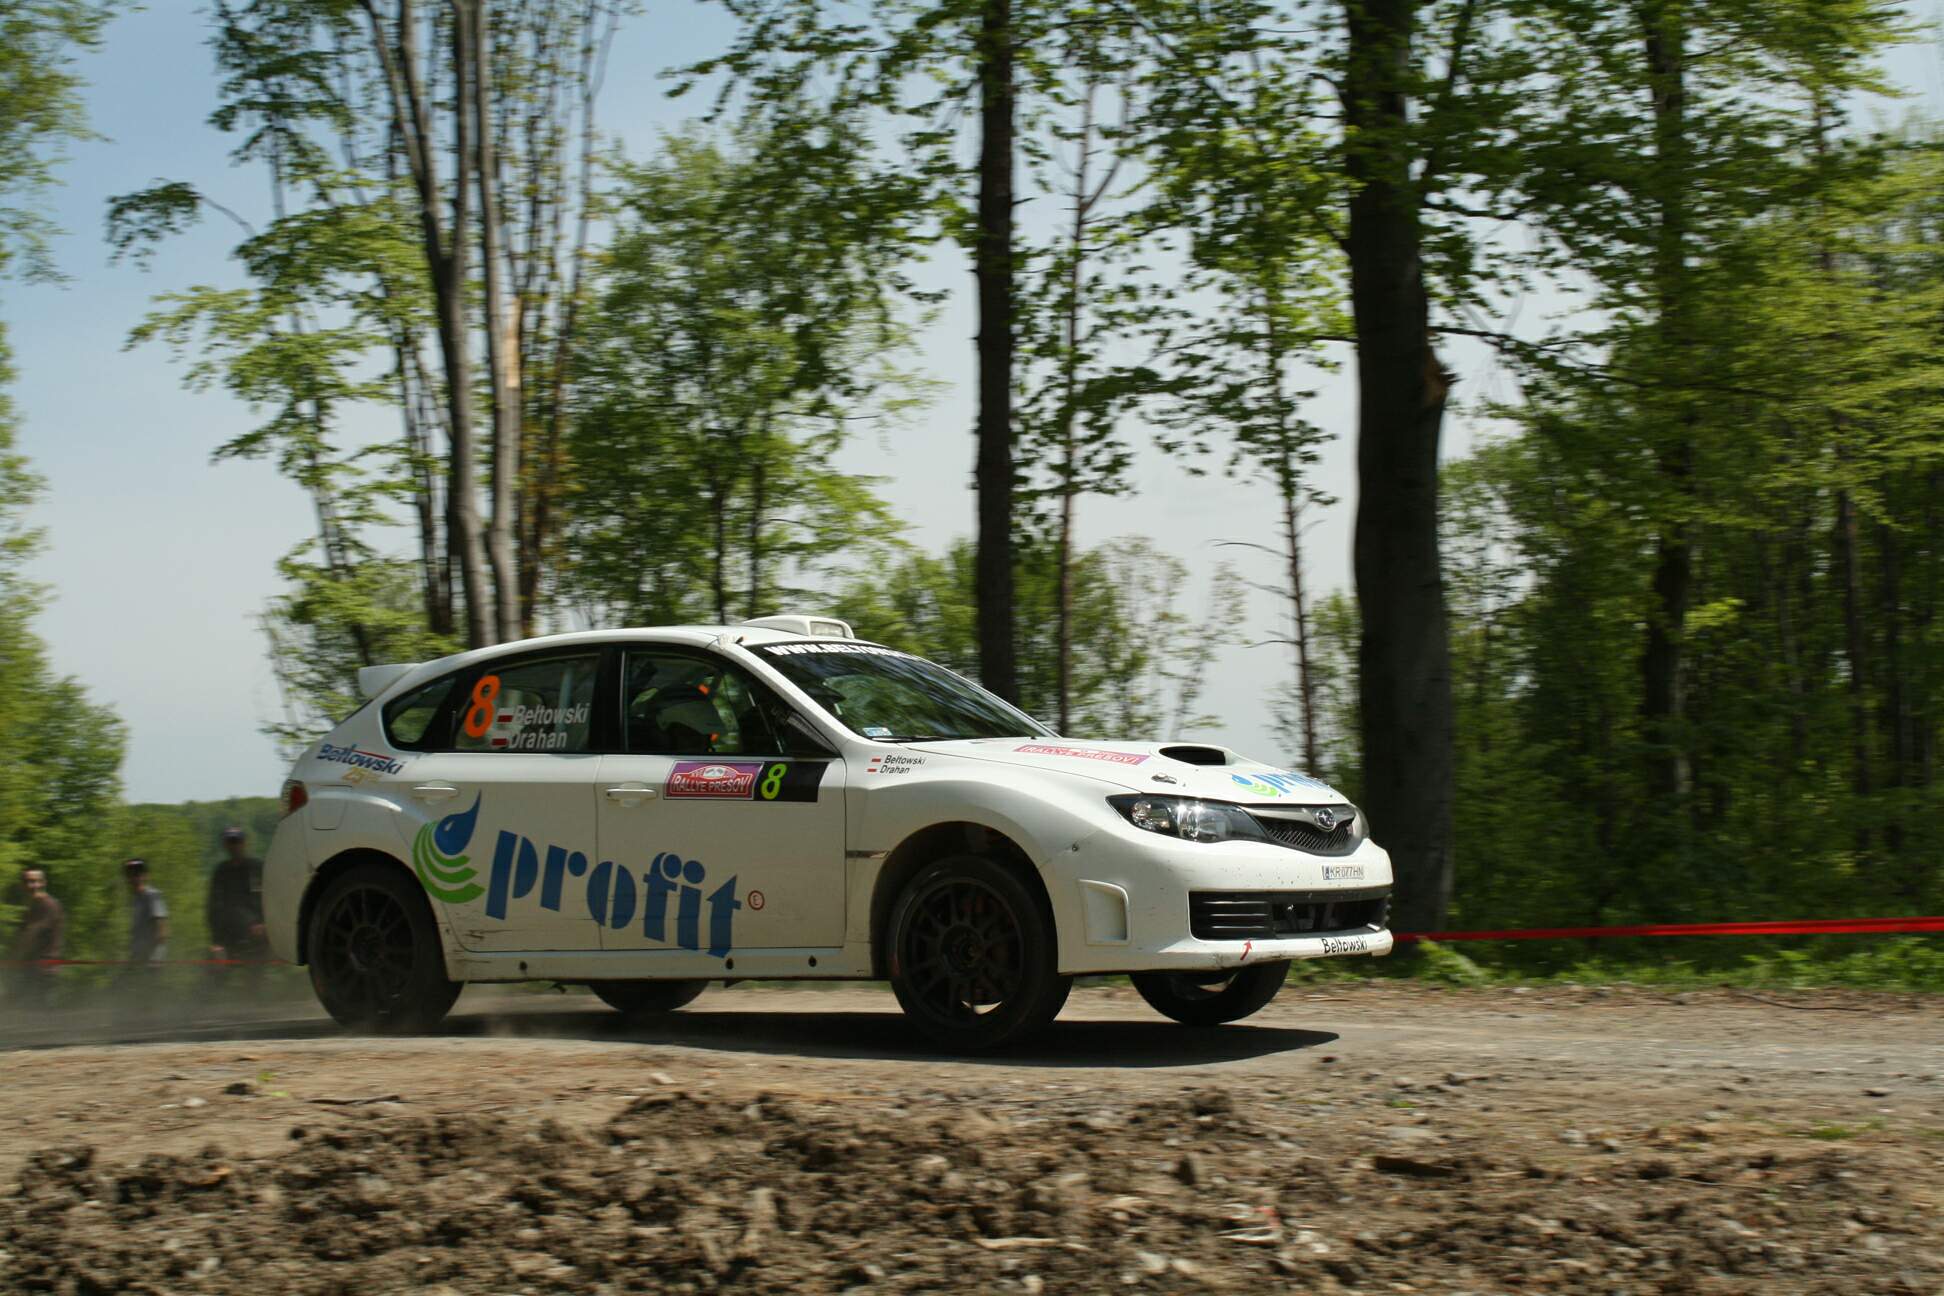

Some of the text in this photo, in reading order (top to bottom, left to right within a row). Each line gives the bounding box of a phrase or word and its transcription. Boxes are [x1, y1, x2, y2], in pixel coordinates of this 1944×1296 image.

[464, 675, 501, 737] 8
[672, 774, 707, 792] RALLYE
[760, 763, 788, 800] 8
[485, 829, 742, 959] profit
